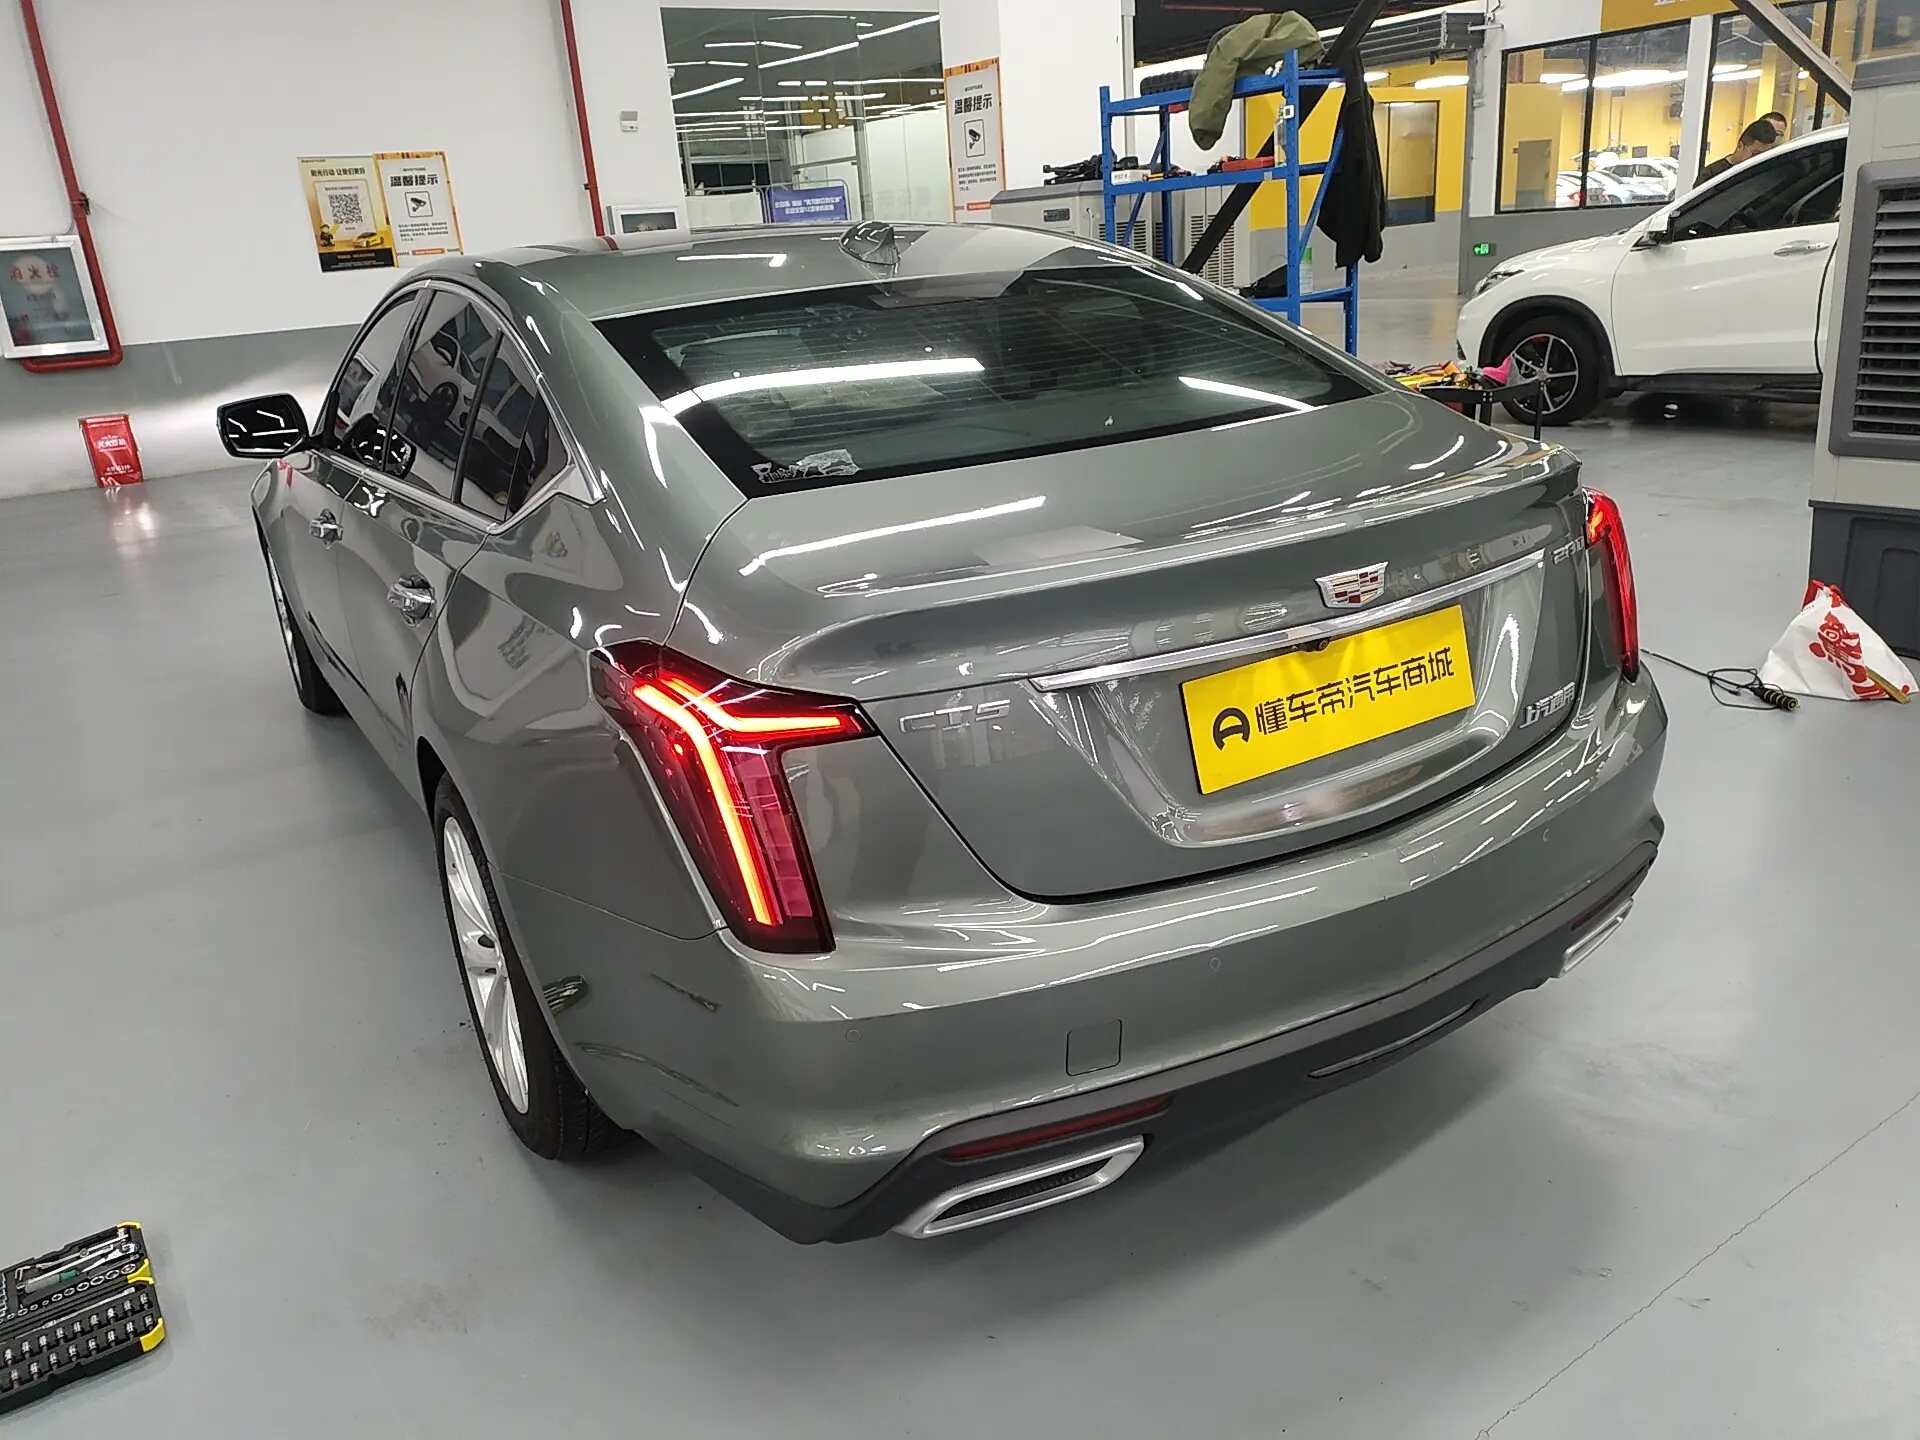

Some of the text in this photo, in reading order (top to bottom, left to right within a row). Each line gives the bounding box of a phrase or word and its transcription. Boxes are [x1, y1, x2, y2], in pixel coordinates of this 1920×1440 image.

[954, 93, 993, 115] 温馨提示
[390, 173, 438, 187] 温馨提示
[9, 264, 60, 281] 消火栓
[1255, 646, 1455, 736] 懂车帝汽车商城
[1519, 681, 1575, 729] 上汽通用
